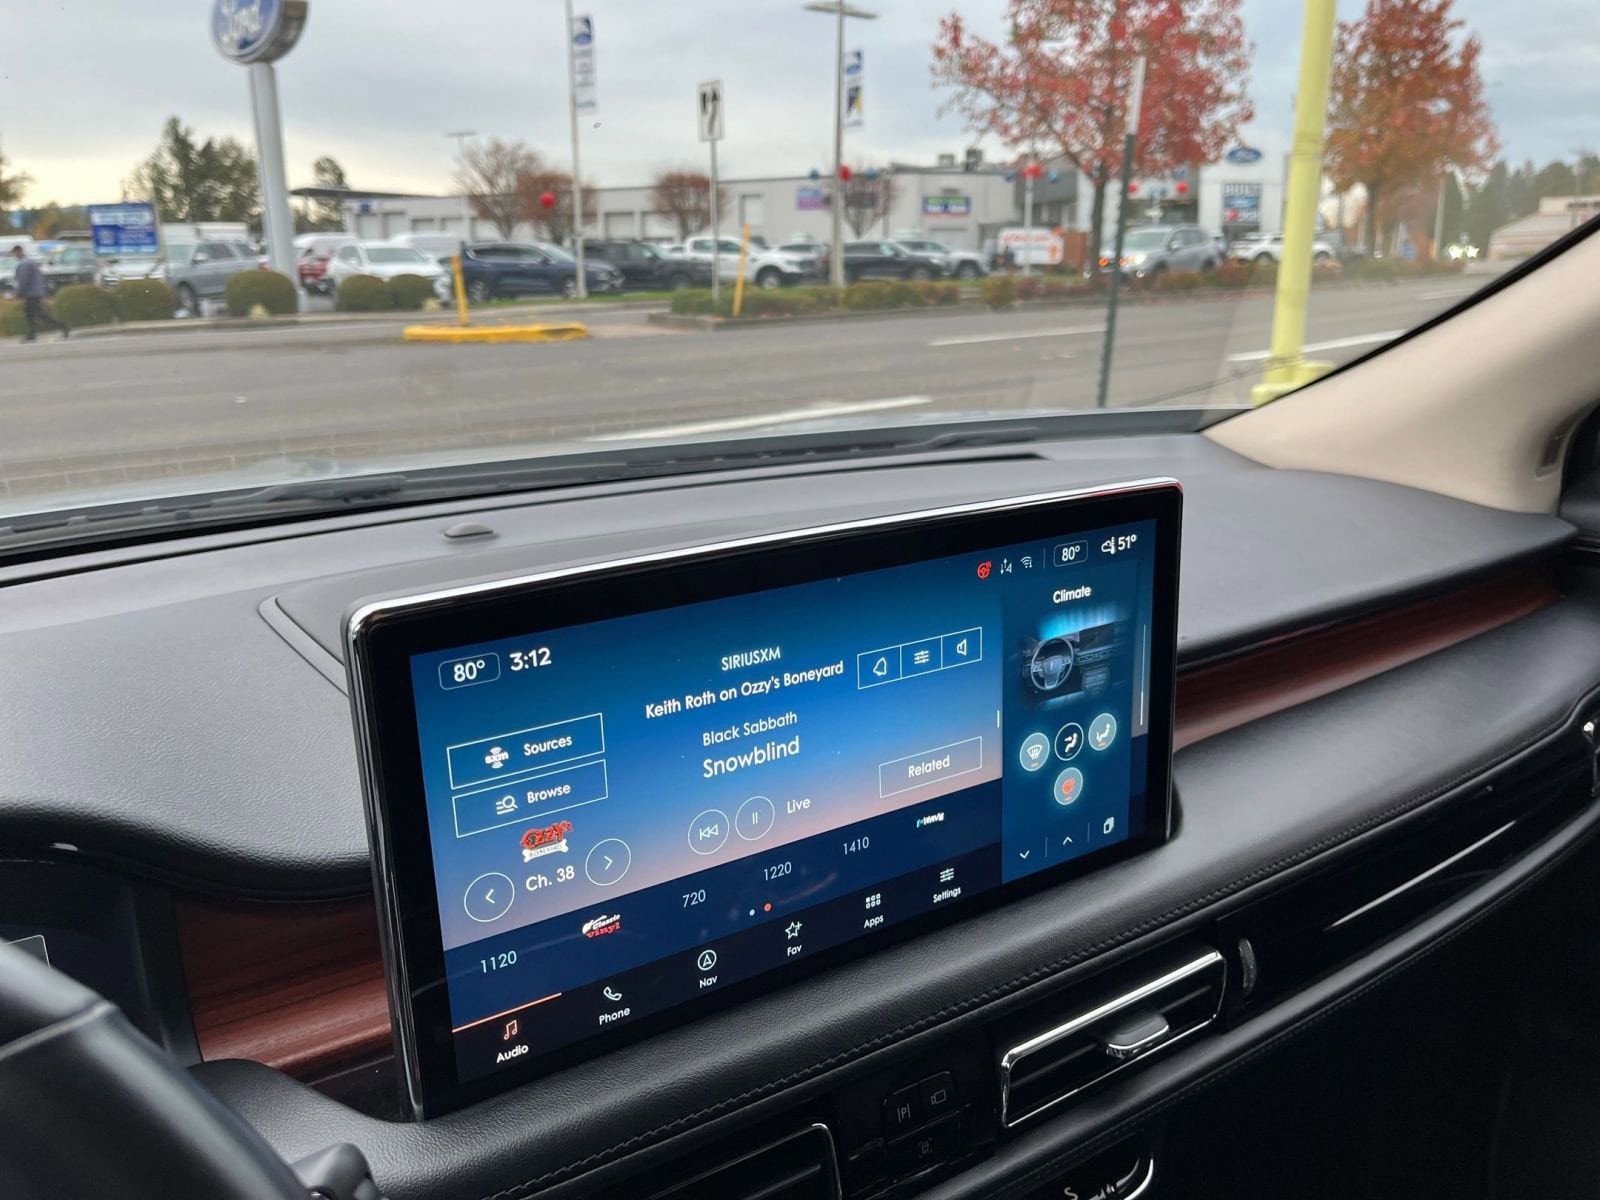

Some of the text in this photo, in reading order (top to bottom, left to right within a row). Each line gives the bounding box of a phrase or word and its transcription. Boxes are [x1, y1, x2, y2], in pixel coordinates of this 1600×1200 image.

[1052, 585, 1092, 604] Climate
[509, 647, 552, 671] 3:12
[720, 646, 781, 672] SIRIUSXM
[453, 660, 486, 682] 80°
[645, 661, 844, 719] Keith Roth on Ozzy's Boneyard
[702, 712, 798, 746] Black Sabbath
[523, 735, 573, 756] Sources
[702, 736, 800, 779] Snowblind
[908, 754, 951, 778] Related
[526, 783, 571, 804] Browse
[786, 797, 811, 814] Live
[842, 836, 870, 855] 1410
[525, 866, 575, 891] Ch. 38
[763, 861, 792, 881] 1220
[682, 889, 706, 908] 720
[933, 886, 961, 903] Settings
[864, 914, 884, 929] Apps
[787, 944, 802, 956] Fav
[480, 950, 517, 973] 1120
[699, 974, 718, 988] Nav
[598, 1006, 631, 1025] Phone
[496, 1043, 529, 1063] Audio
